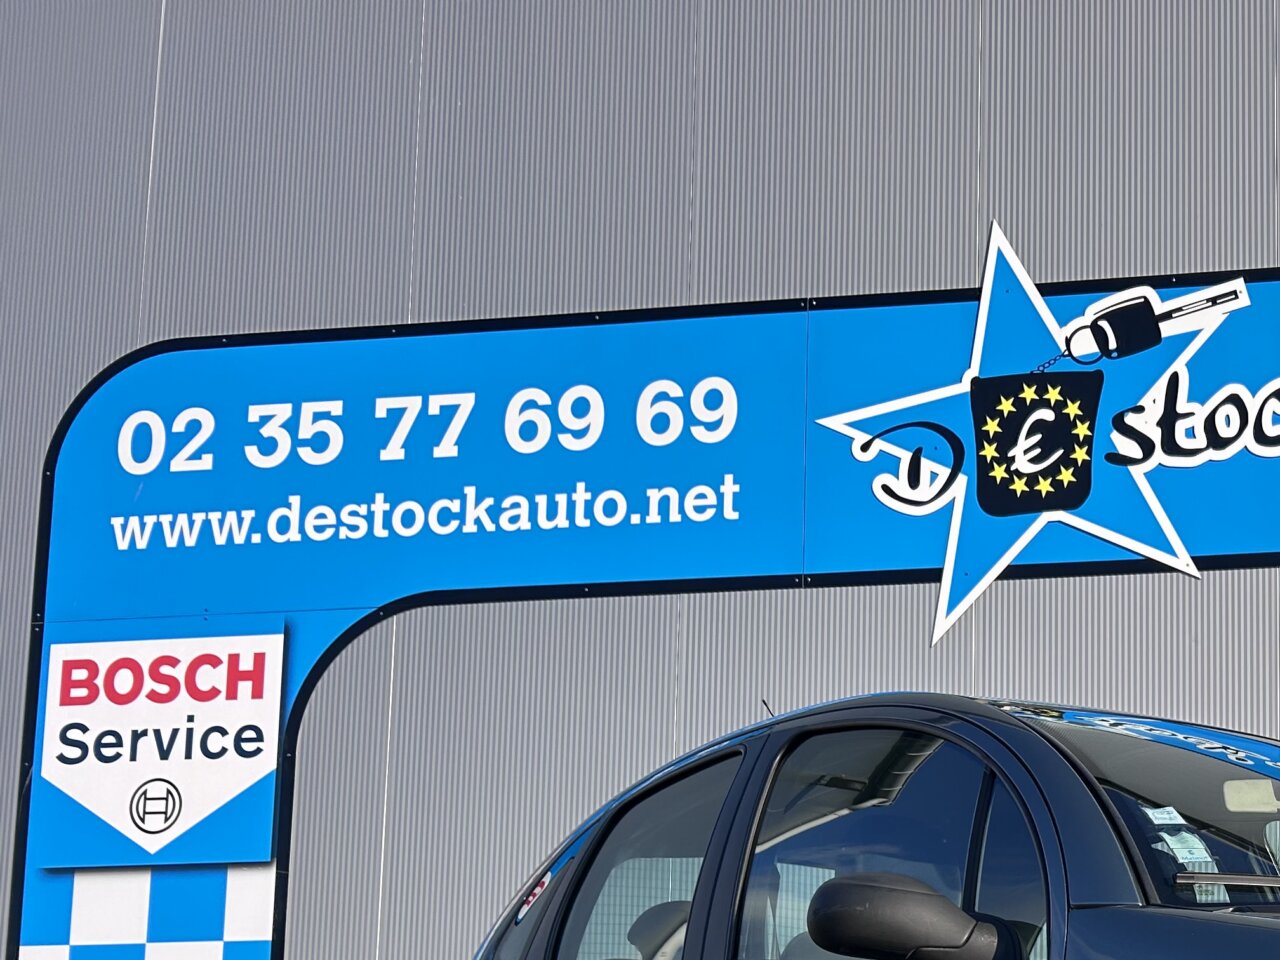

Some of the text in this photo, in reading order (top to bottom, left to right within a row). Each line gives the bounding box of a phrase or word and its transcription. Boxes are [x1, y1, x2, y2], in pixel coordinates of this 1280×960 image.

[117, 376, 738, 475] 02 35 77 69 69
[110, 473, 740, 550] www.destockauto.net
[59, 651, 266, 707] BOSCH
[55, 713, 265, 765] Service
